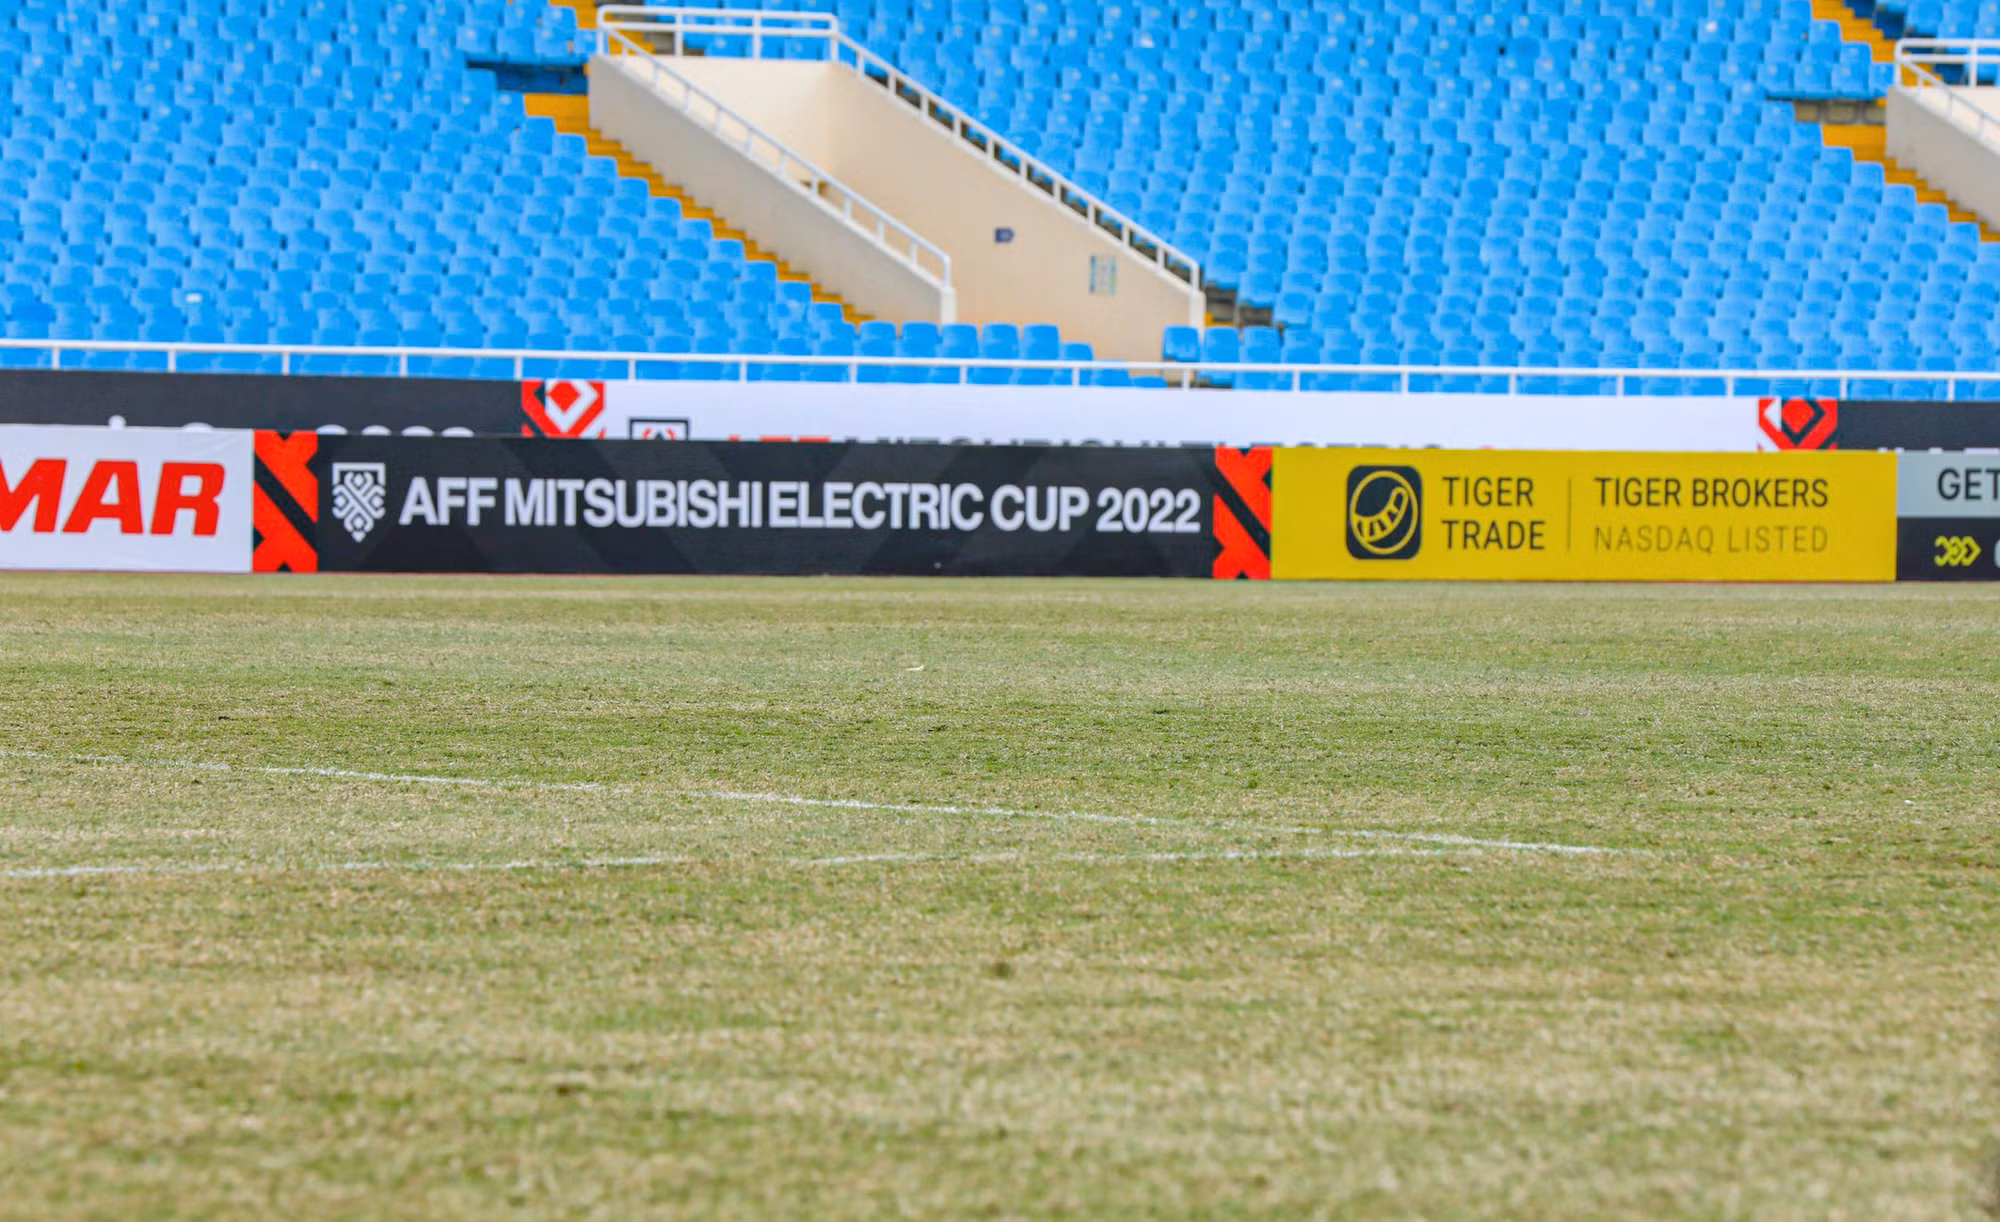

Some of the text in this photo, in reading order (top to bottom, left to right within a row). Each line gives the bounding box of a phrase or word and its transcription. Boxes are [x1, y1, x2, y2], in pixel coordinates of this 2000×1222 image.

[399, 476, 1201, 533] AFF MITSUBISHI ELECTRIC CUP 2022
[1441, 475, 1535, 507] TIGER
[1594, 476, 1830, 508] TIGER BROKERS
[1441, 519, 1546, 551] TRADE
[1593, 525, 1829, 555] NASDAQ LISTED
